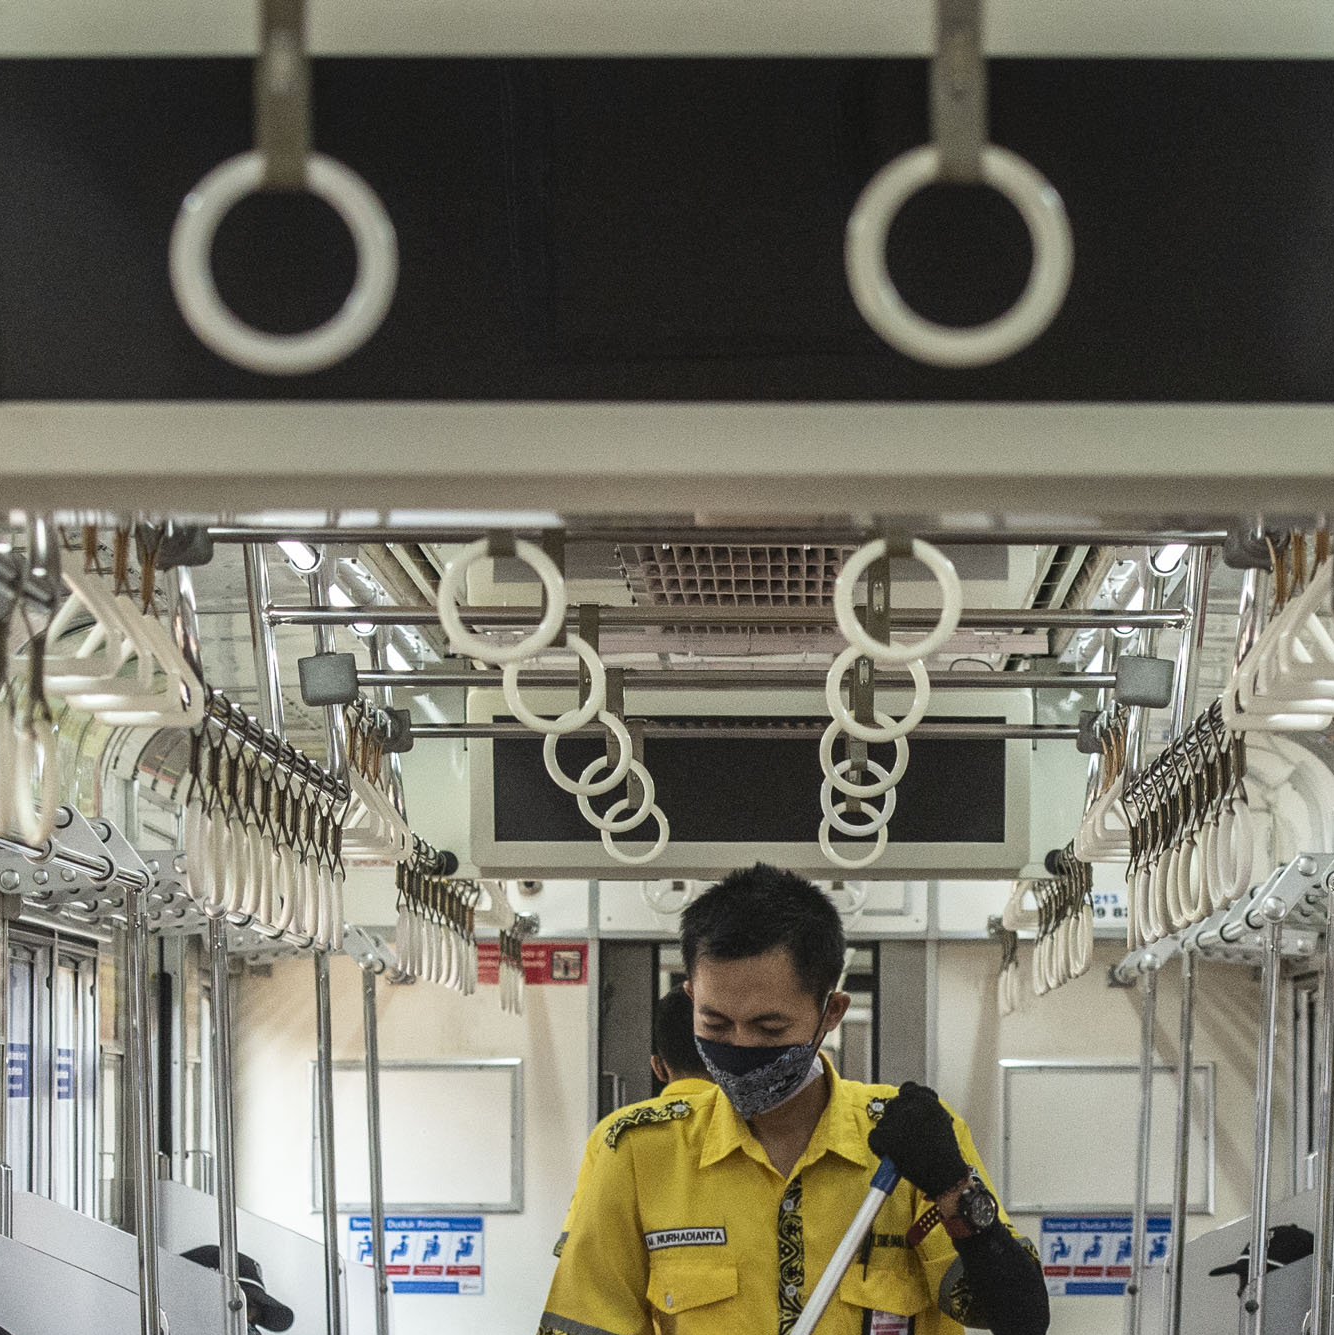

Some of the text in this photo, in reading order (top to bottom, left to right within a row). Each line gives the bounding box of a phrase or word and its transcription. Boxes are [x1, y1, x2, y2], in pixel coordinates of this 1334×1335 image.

[352, 1219, 372, 1229] Tem
[387, 1219, 414, 1229] Duduk
[657, 1231, 723, 1245] NURHADIANTA
